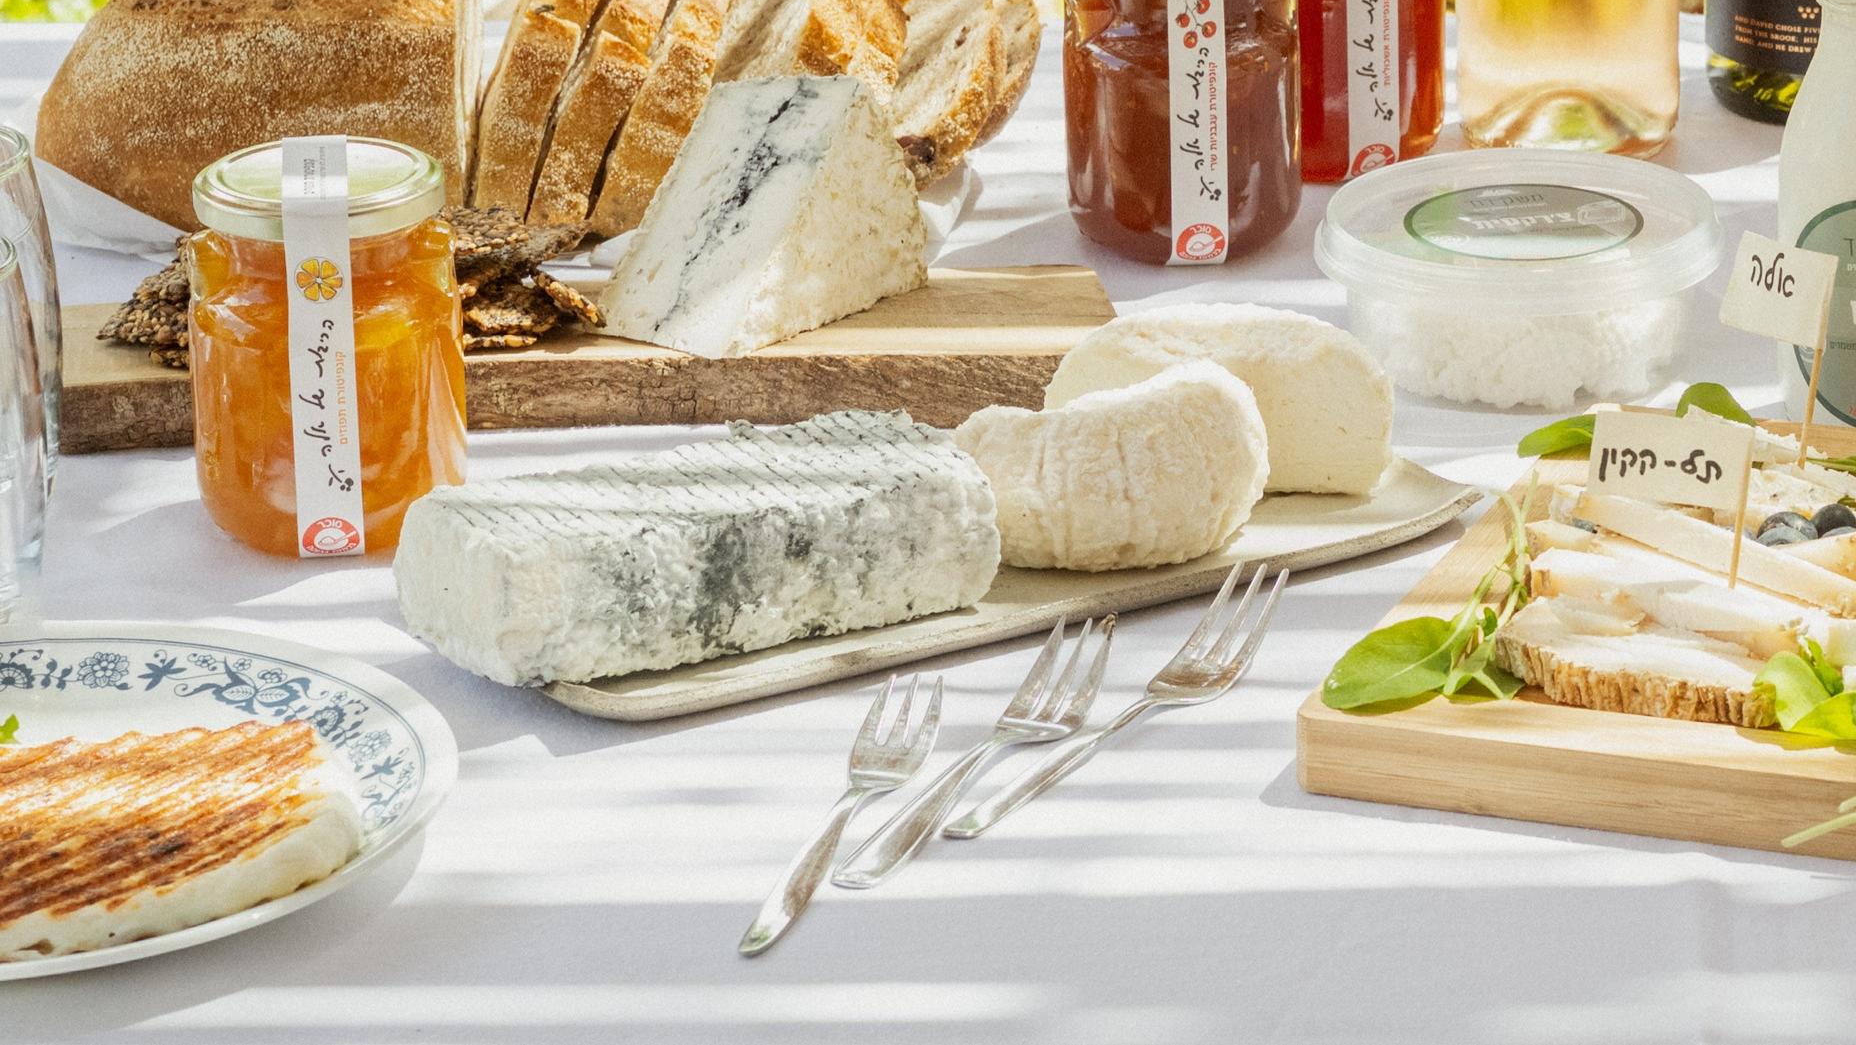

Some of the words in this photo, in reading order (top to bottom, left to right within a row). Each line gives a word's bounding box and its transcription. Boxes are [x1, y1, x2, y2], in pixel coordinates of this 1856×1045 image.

[1775, 24, 1802, 33] CHOSE
[1353, 34, 1374, 52] של
[1208, 61, 1217, 111] קונפיטורת
[1177, 109, 1200, 128] של
[336, 351, 346, 405] קונפיטורת
[299, 388, 325, 411] של
[338, 408, 348, 445] תפוזים
[316, 519, 343, 528] סוכר
